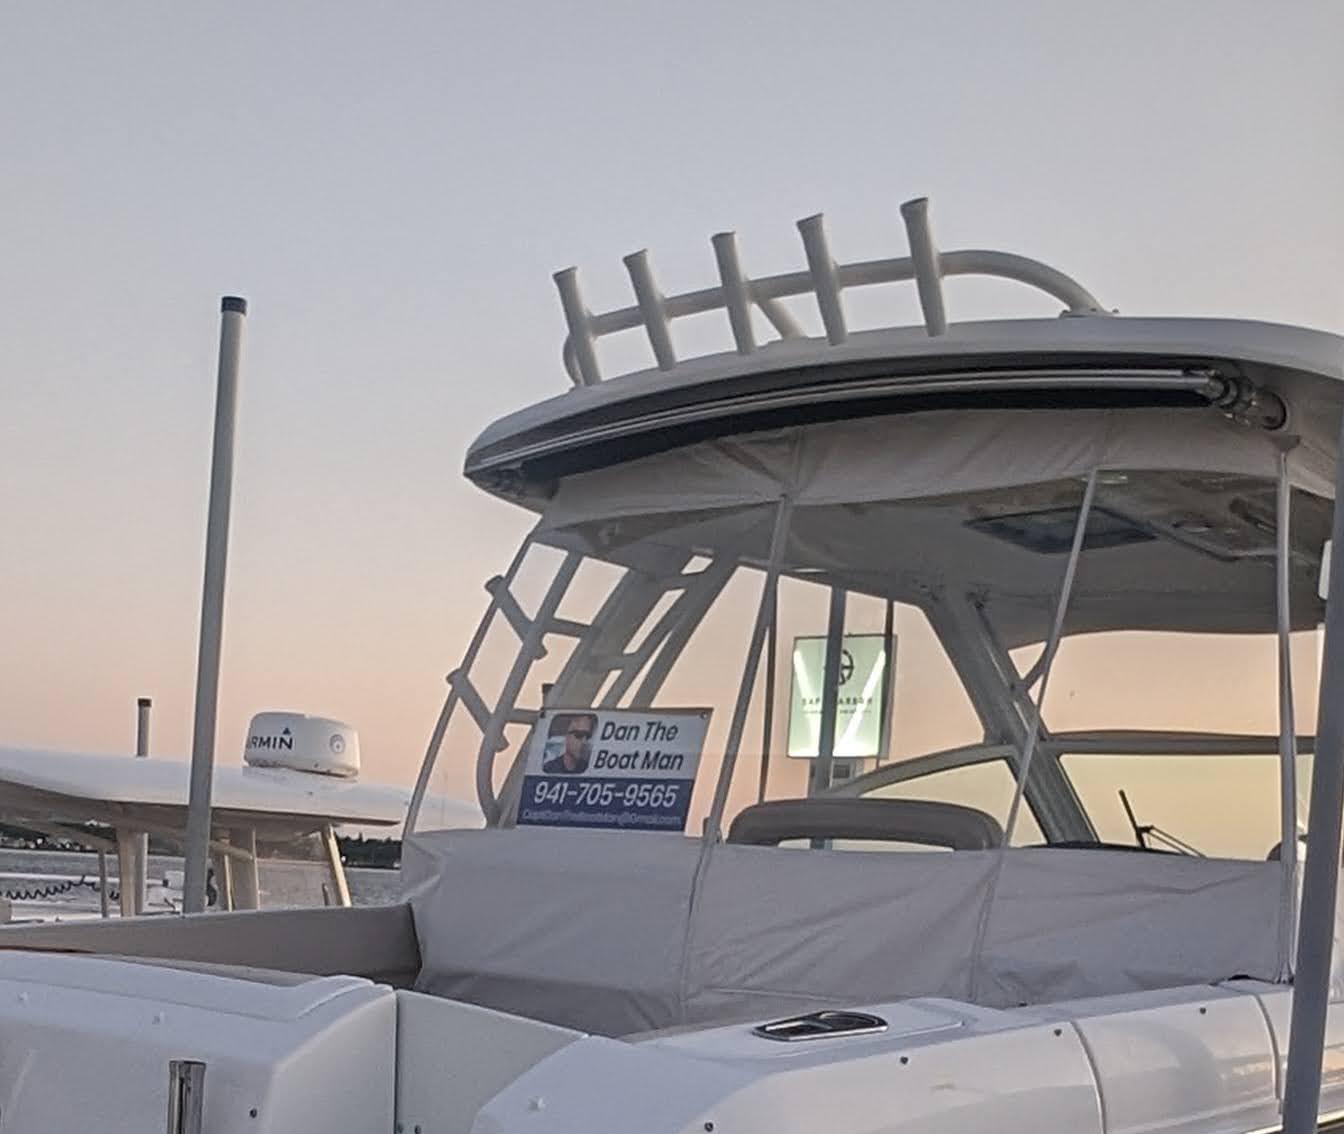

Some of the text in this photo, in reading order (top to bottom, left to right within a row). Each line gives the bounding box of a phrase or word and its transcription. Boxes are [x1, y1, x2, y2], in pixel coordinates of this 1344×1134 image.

[600, 721, 679, 742] Dan The
[250, 735, 293, 750] RMIN
[594, 750, 684, 771] Boat Man
[534, 781, 680, 808] 941-705-9565
